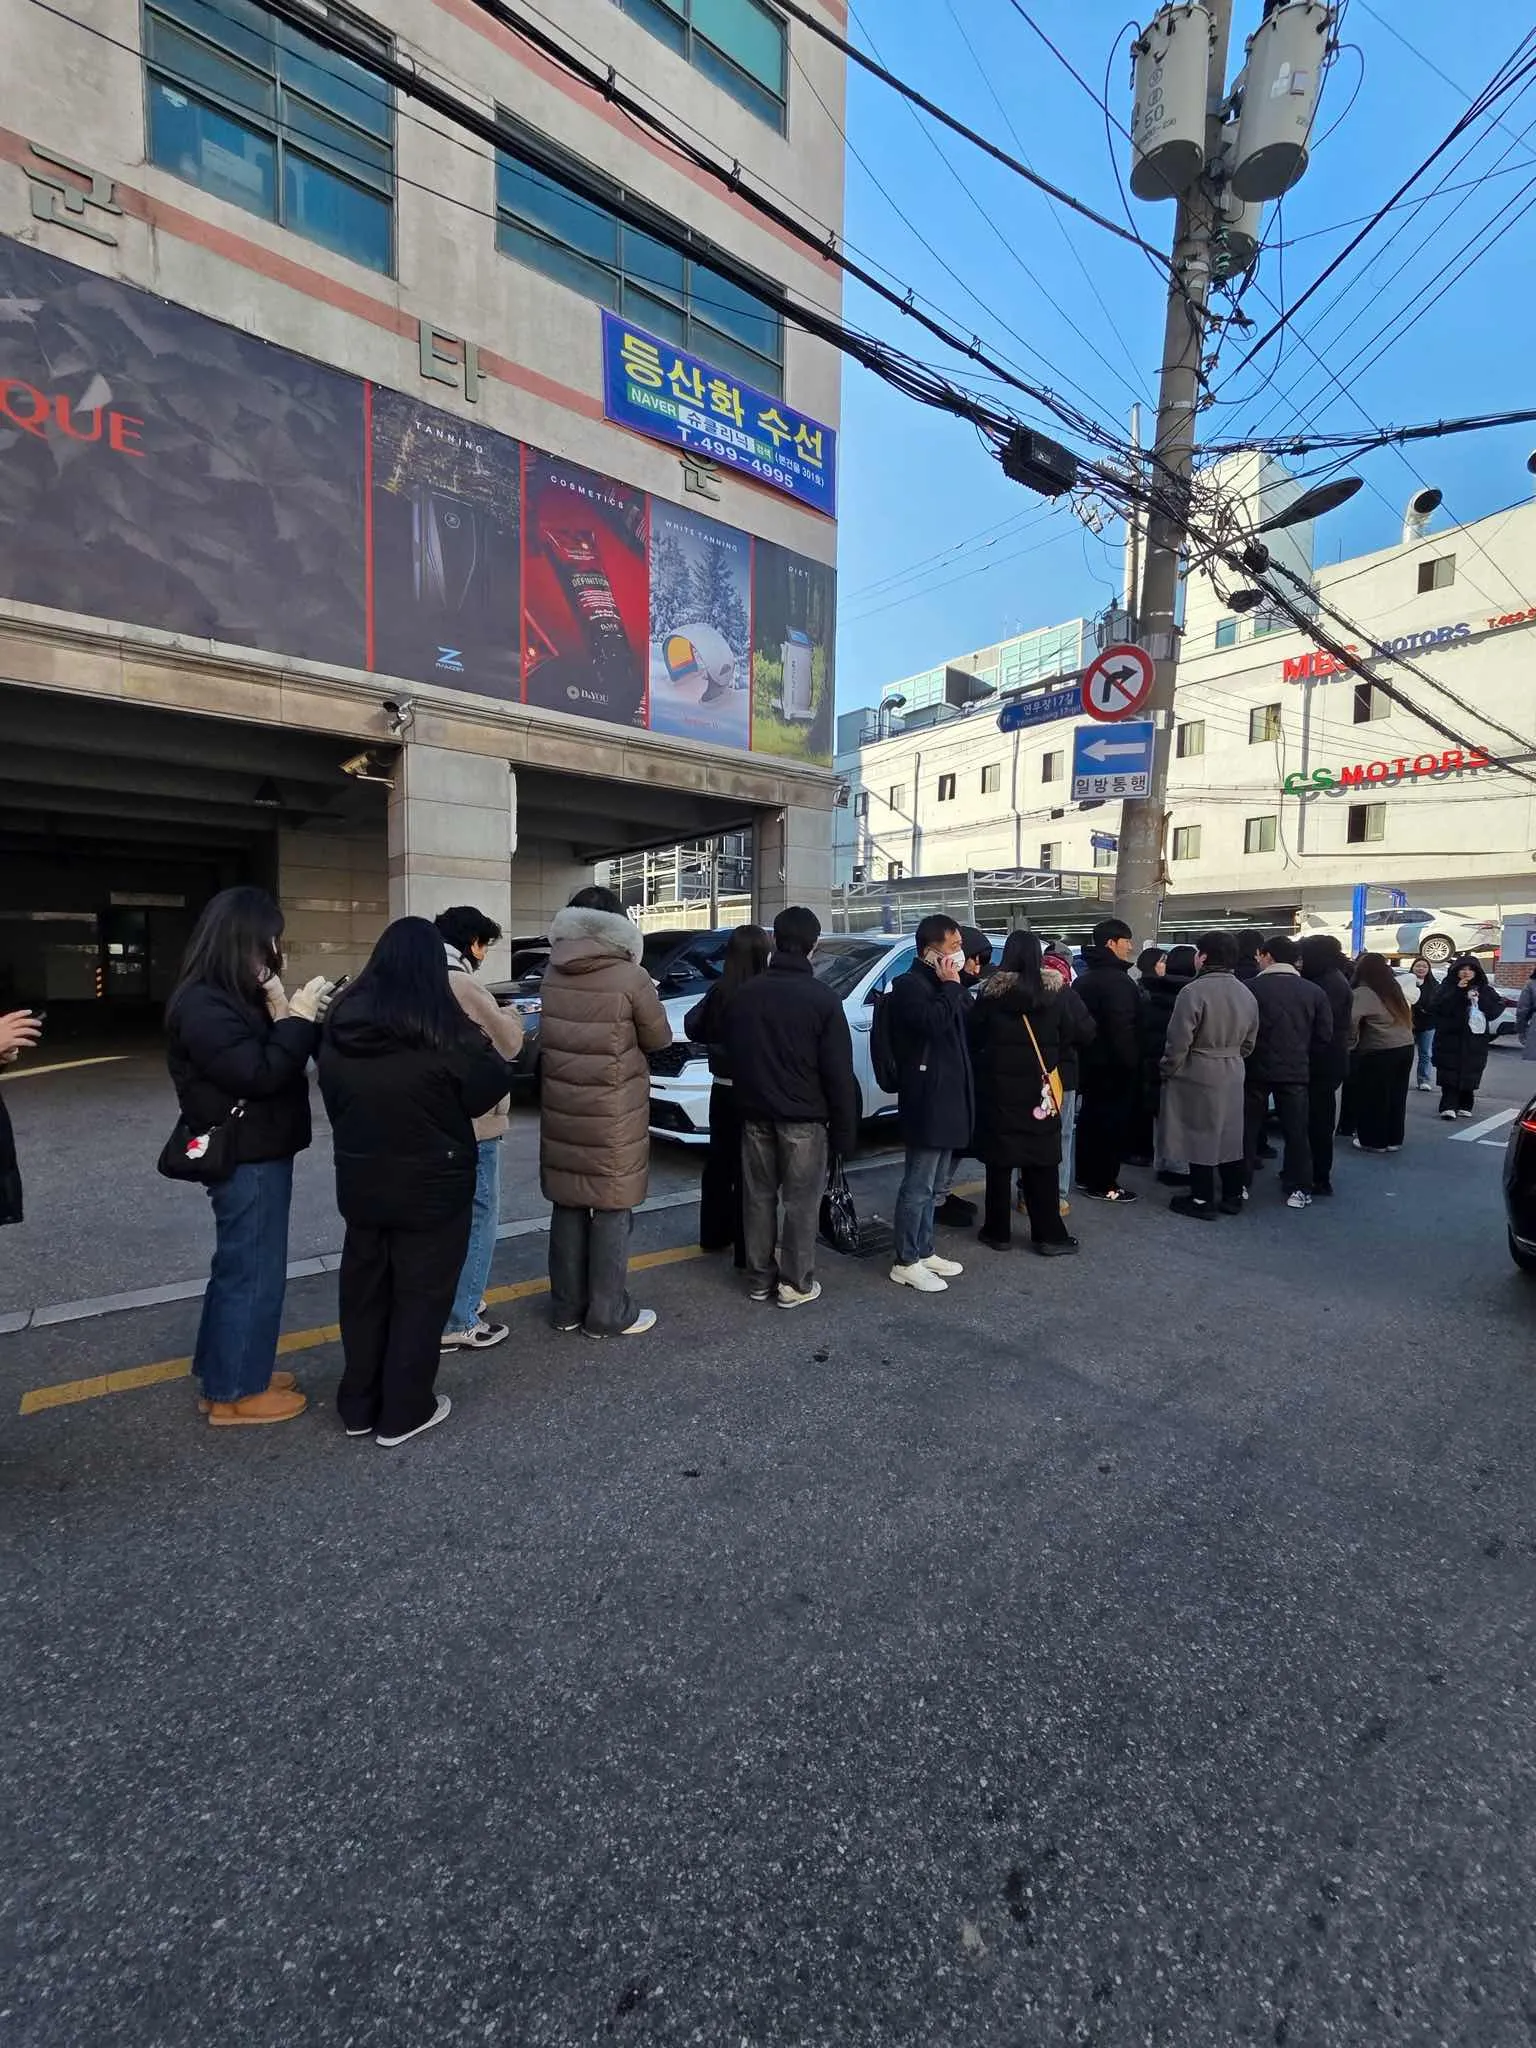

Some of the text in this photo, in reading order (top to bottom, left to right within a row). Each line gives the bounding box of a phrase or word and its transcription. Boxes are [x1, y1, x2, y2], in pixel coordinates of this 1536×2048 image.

[620, 332, 823, 469] 등산화 수선
[631, 387, 677, 417] NAVER
[416, 421, 483, 454] TANNING
[677, 425, 794, 489] T.499-4995
[550, 475, 624, 509] COSMETICS
[664, 519, 738, 552] WHITE TANNING
[788, 566, 809, 577] DIET
[1371, 622, 1471, 656] MOTORS
[1341, 746, 1489, 785] MOTORS
[1076, 775, 1146, 795] 일방통행
